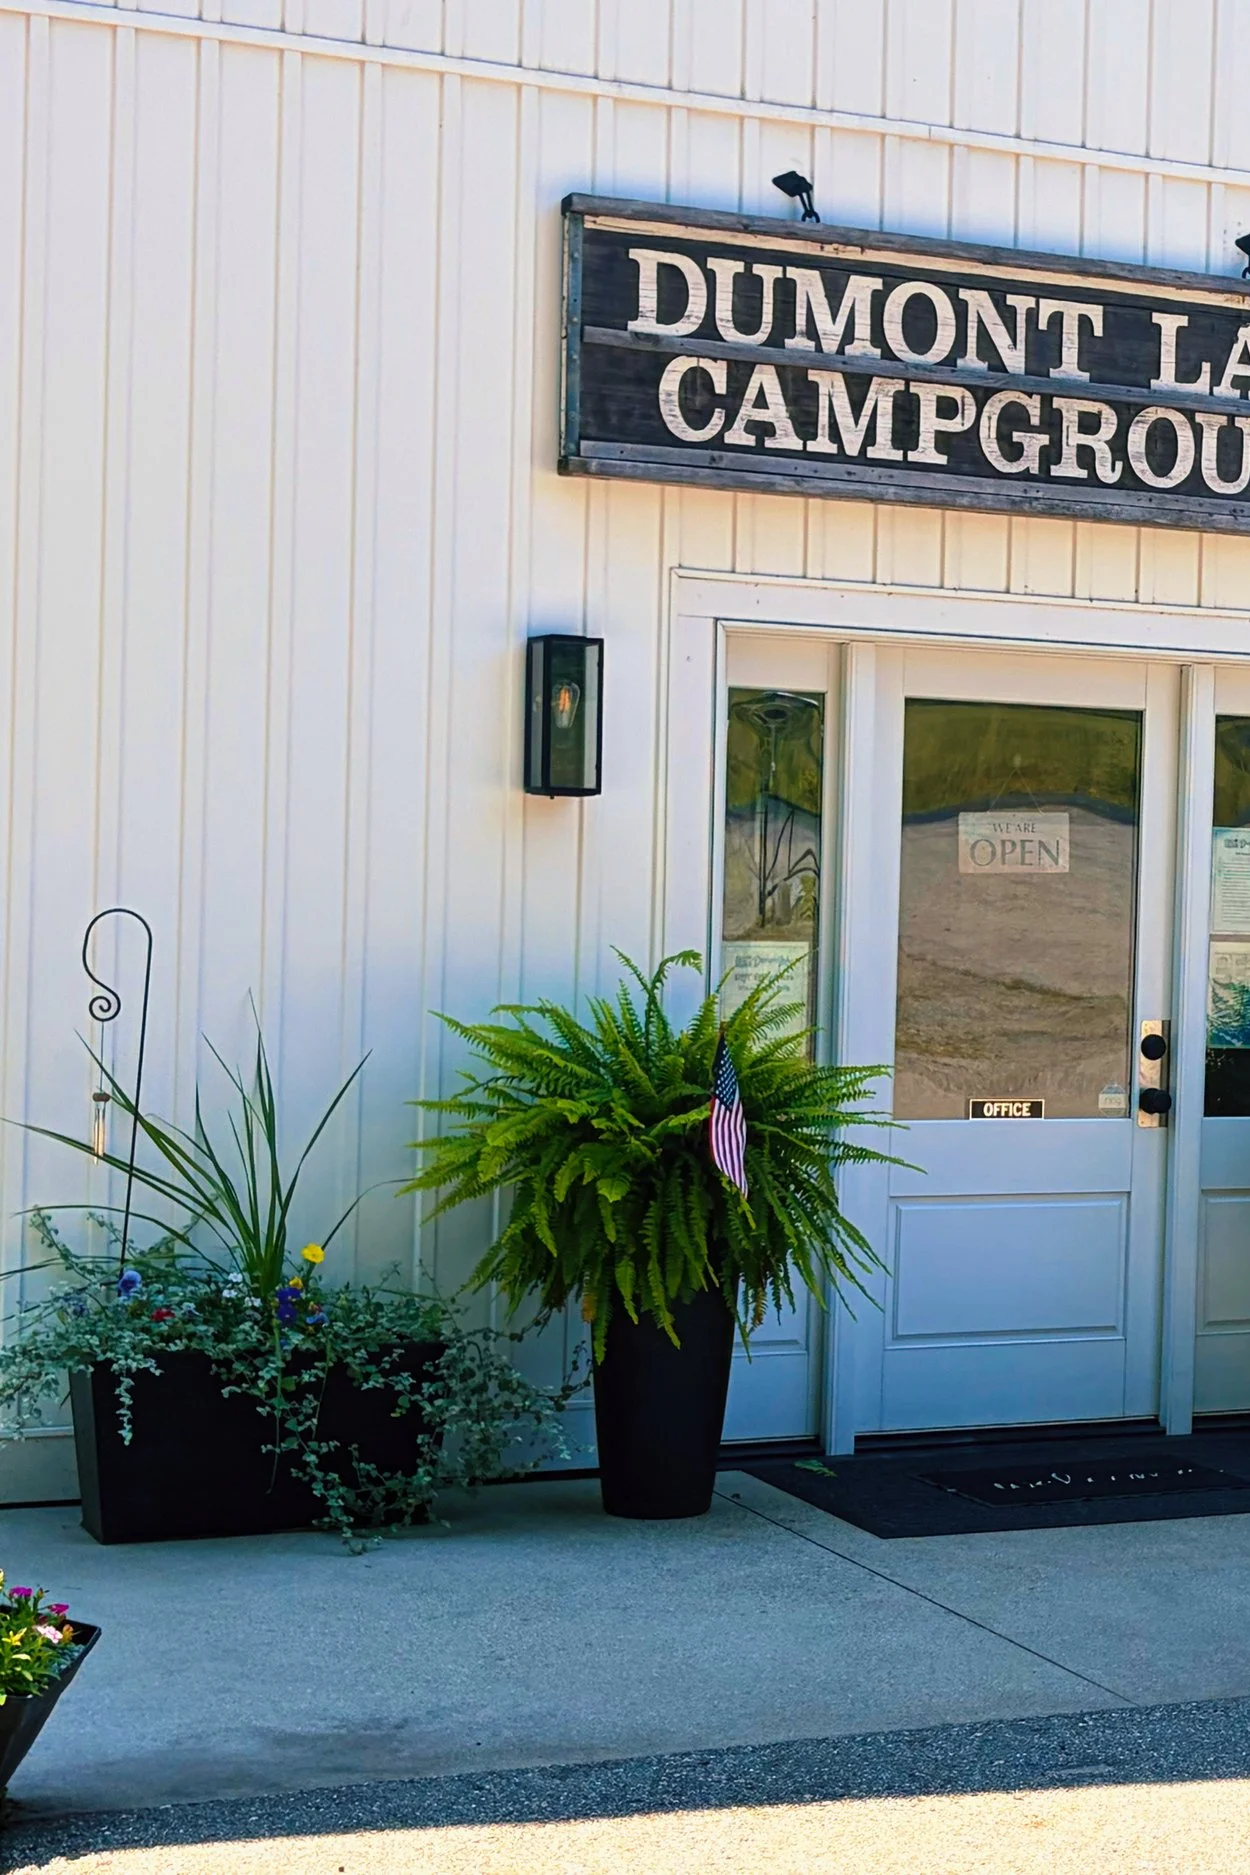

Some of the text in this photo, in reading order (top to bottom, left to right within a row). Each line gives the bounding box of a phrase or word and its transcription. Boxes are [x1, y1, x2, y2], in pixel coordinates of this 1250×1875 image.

[627, 246, 1104, 381] DUMONT
[993, 823, 1036, 833] WE ARE
[970, 839, 1060, 866] OPEN
[983, 1103, 1031, 1117] OFFICE
